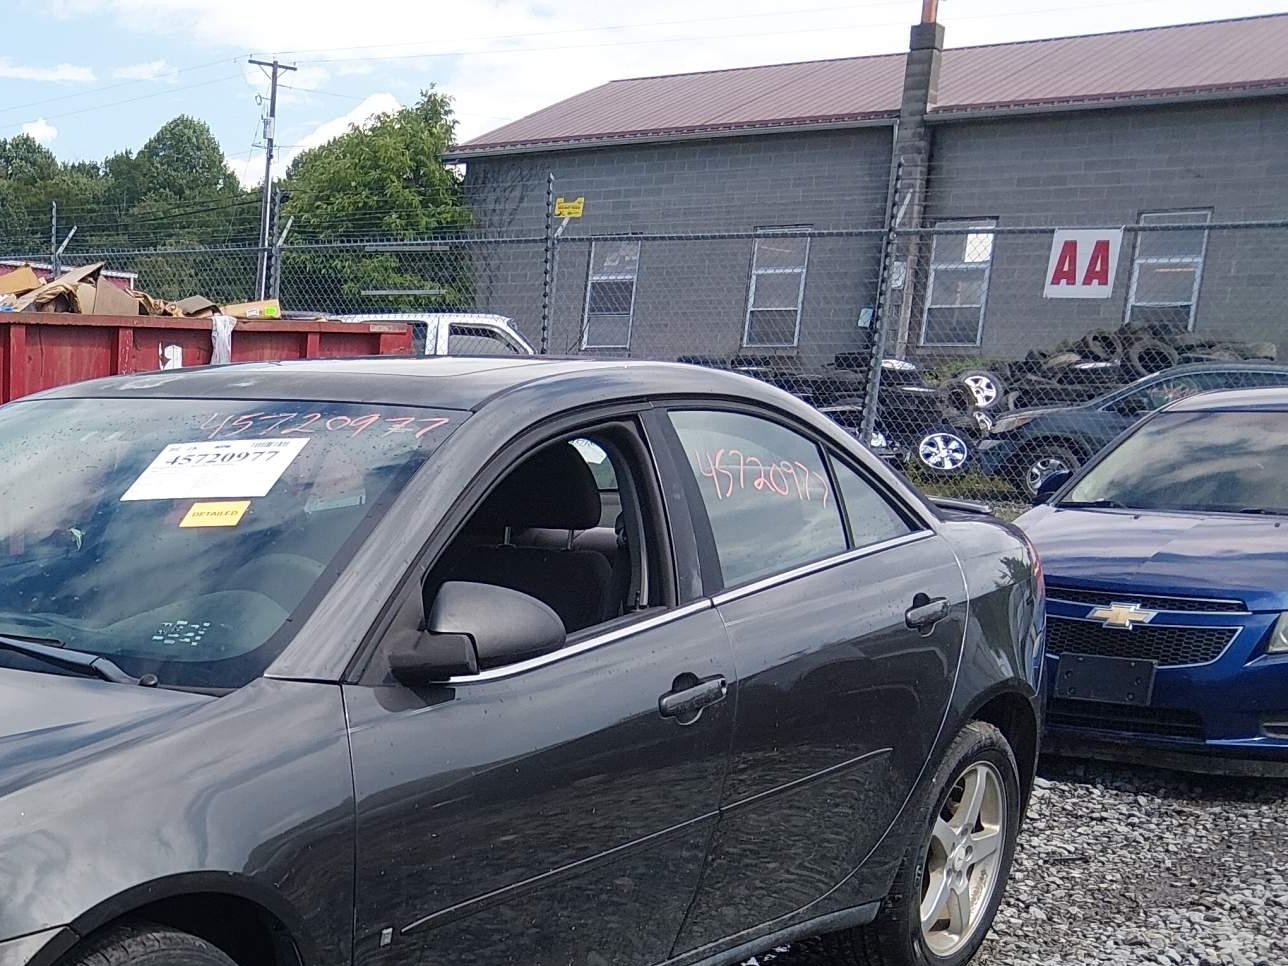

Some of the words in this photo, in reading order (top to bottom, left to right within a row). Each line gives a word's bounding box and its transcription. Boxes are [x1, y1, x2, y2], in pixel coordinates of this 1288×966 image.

[1050, 239, 1110, 286] AA
[199, 412, 450, 440] 45720977
[165, 450, 281, 466] 45720977
[695, 448, 829, 509] 45720977
[190, 509, 240, 519] DETAILED
